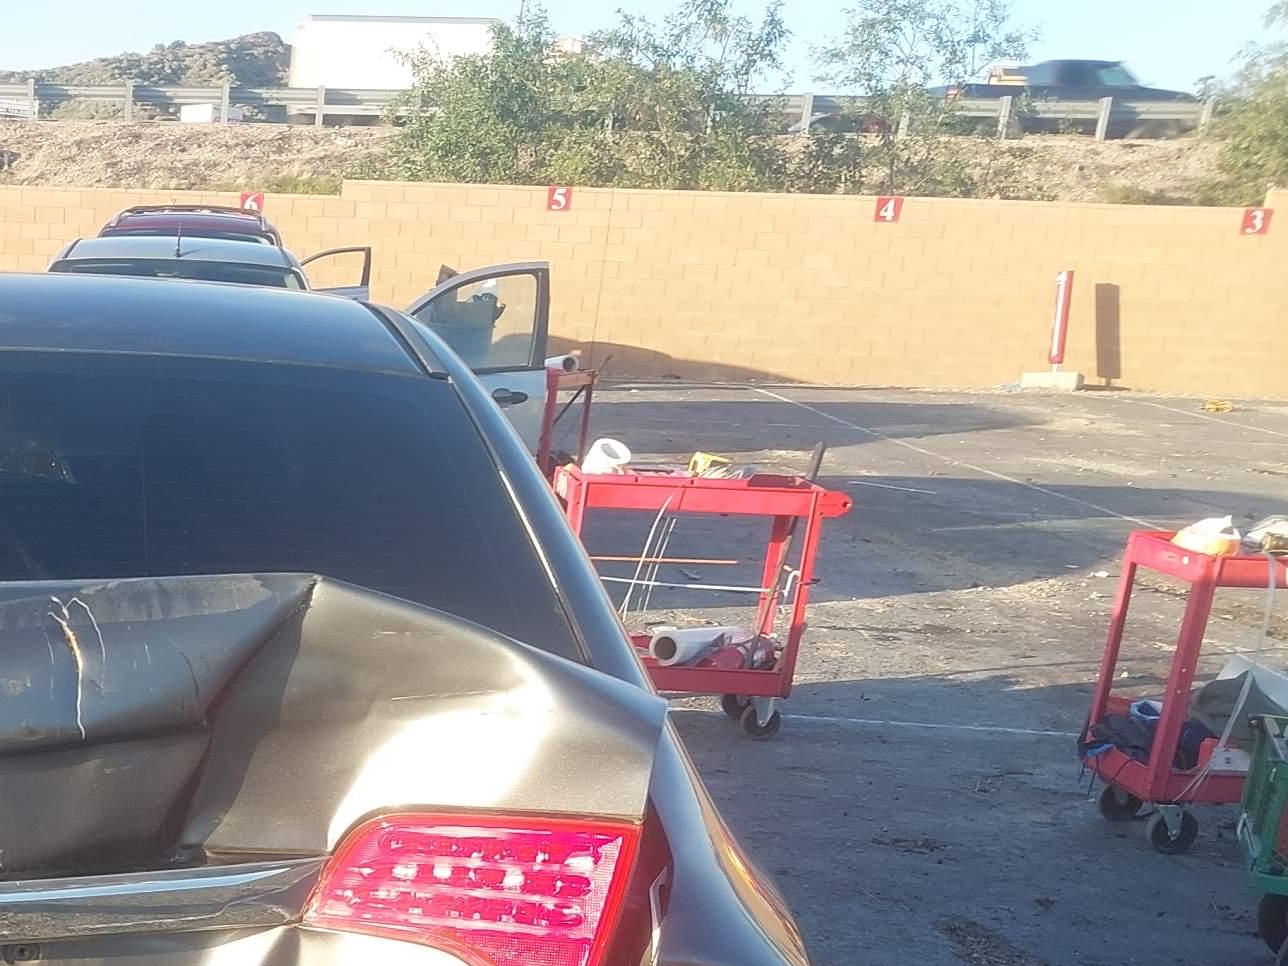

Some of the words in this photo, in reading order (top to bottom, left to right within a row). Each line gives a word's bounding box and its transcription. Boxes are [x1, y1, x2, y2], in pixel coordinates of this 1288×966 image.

[244, 194, 258, 210] 6
[551, 189, 567, 210] 5
[879, 199, 896, 221] 4
[1245, 210, 1264, 233] 3
